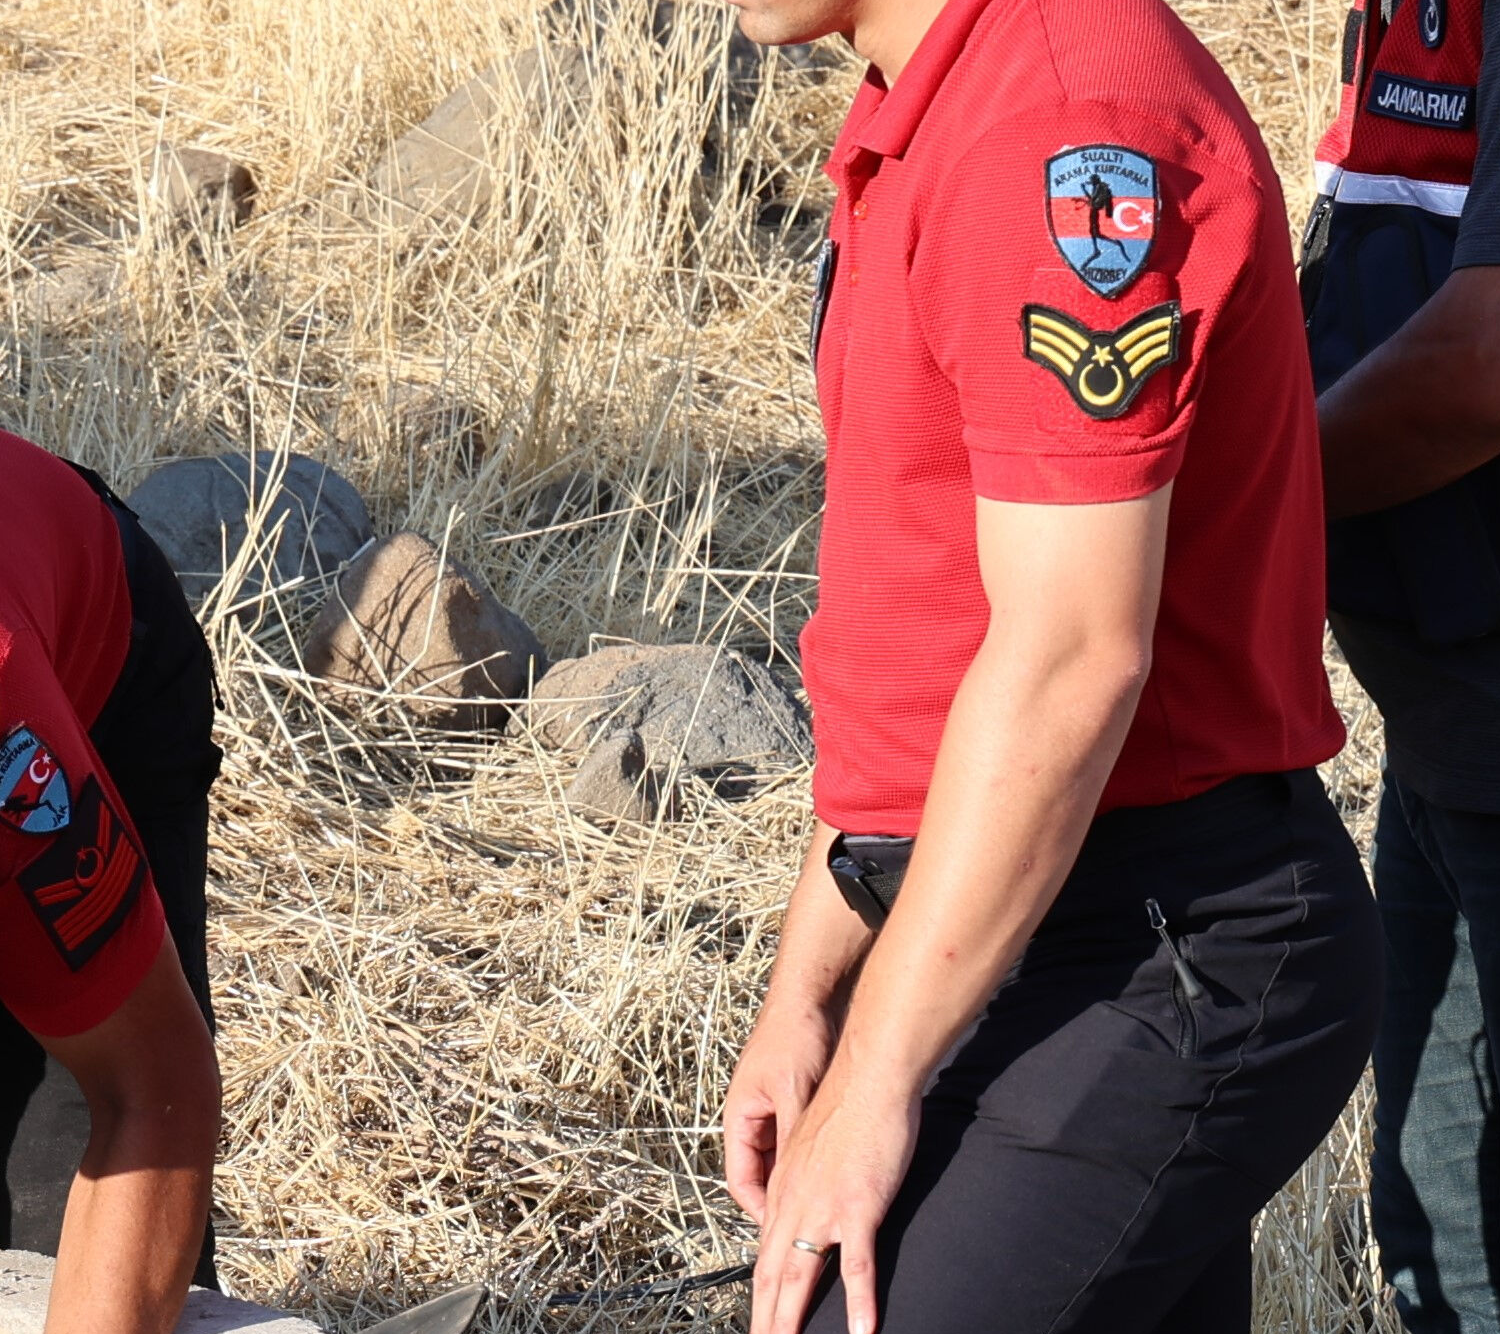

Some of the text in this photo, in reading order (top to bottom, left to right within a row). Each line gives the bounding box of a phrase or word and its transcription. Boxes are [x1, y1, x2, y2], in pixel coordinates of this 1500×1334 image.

[1080, 151, 1124, 164] SUALTI
[1053, 164, 1150, 188] ARAMA KURTARMA
